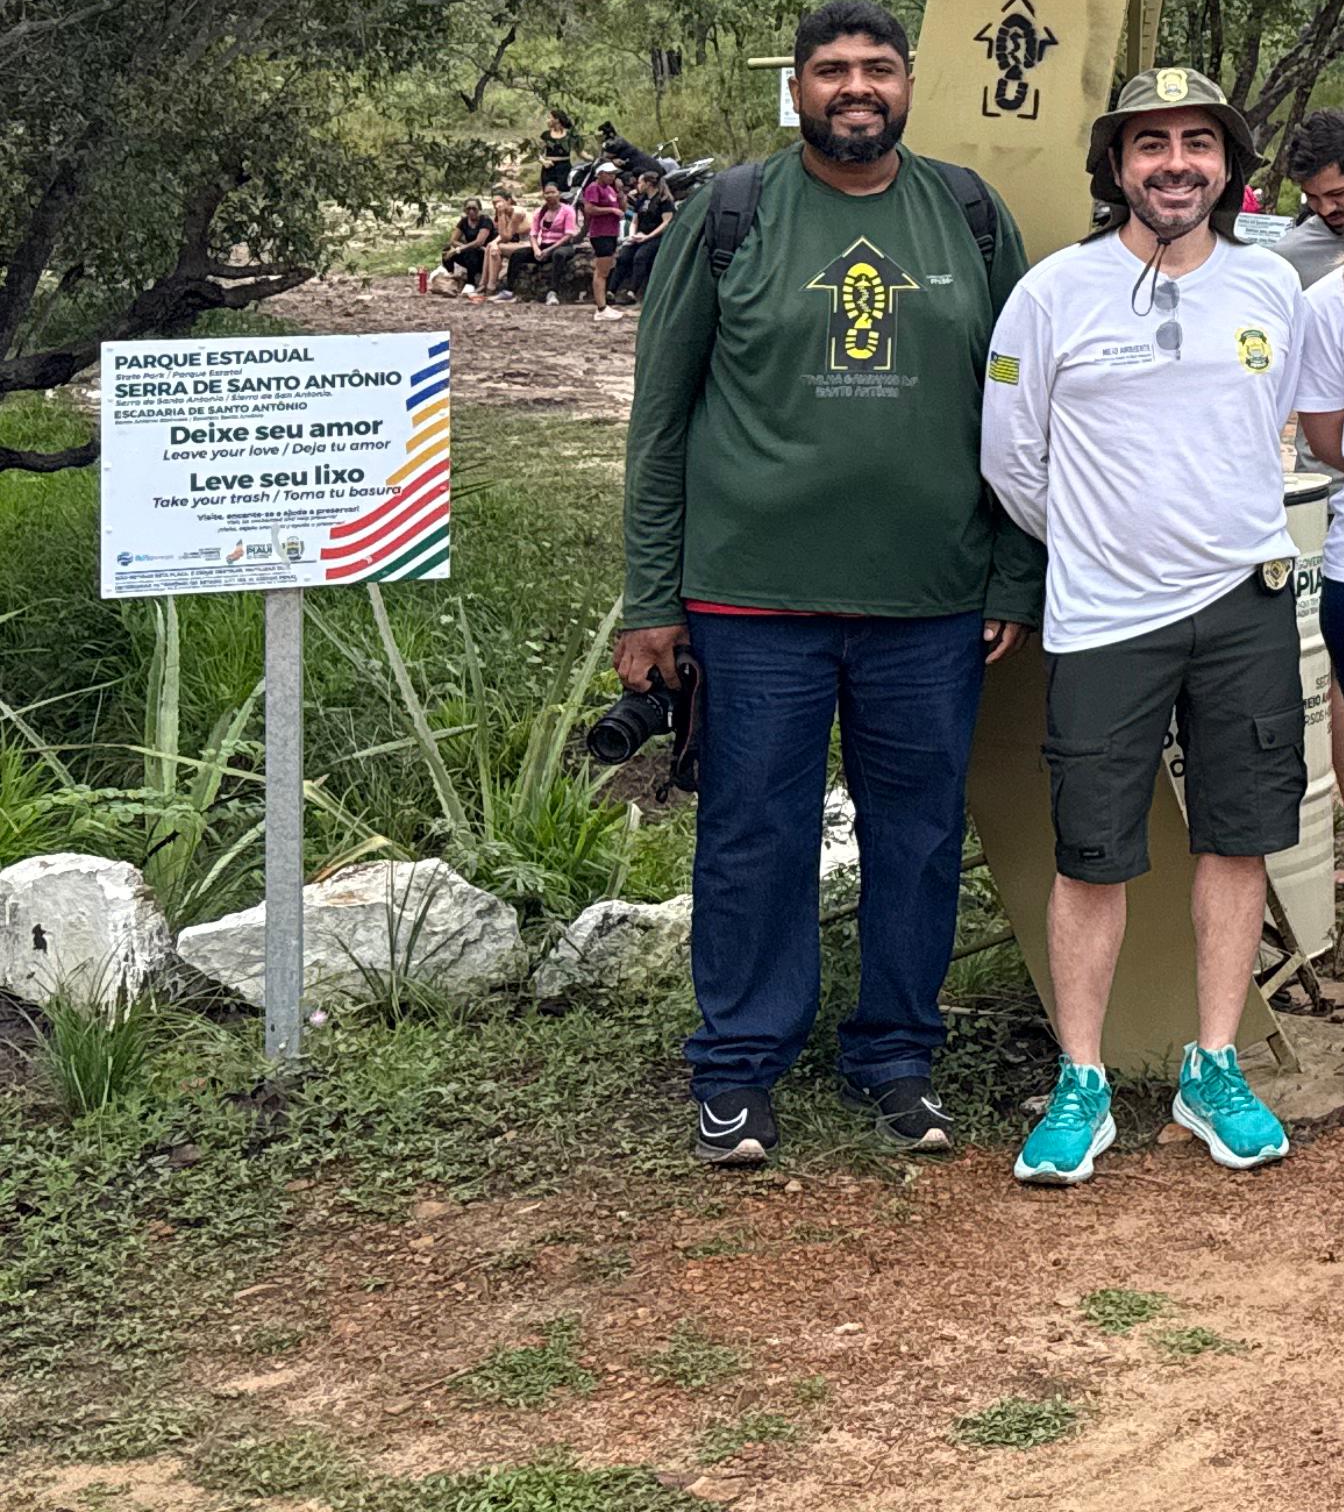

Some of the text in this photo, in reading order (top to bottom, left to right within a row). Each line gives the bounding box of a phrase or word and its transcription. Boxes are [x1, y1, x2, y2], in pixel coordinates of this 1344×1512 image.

[115, 348, 314, 371] PARQUE ESTADUAL
[115, 369, 402, 399] SERRA DE SANTO ANTÔNIO
[114, 407, 186, 419] ESCADARIA
[188, 406, 205, 415] DE
[208, 404, 249, 414] SANTO
[252, 401, 307, 412] ANTÔNIO
[171, 420, 384, 445] Deixe seu amor
[163, 449, 207, 461] Leave
[209, 447, 246, 461] your
[248, 444, 280, 456] love
[292, 441, 327, 455] Deja
[331, 441, 346, 452] tu
[350, 439, 391, 451] amor
[190, 464, 364, 492] Leve seu lixo
[152, 496, 189, 508] Take
[190, 495, 227, 508] your
[230, 491, 270, 504] trash
[283, 489, 325, 501] Toma
[329, 488, 345, 499] tu
[349, 486, 402, 498] basura
